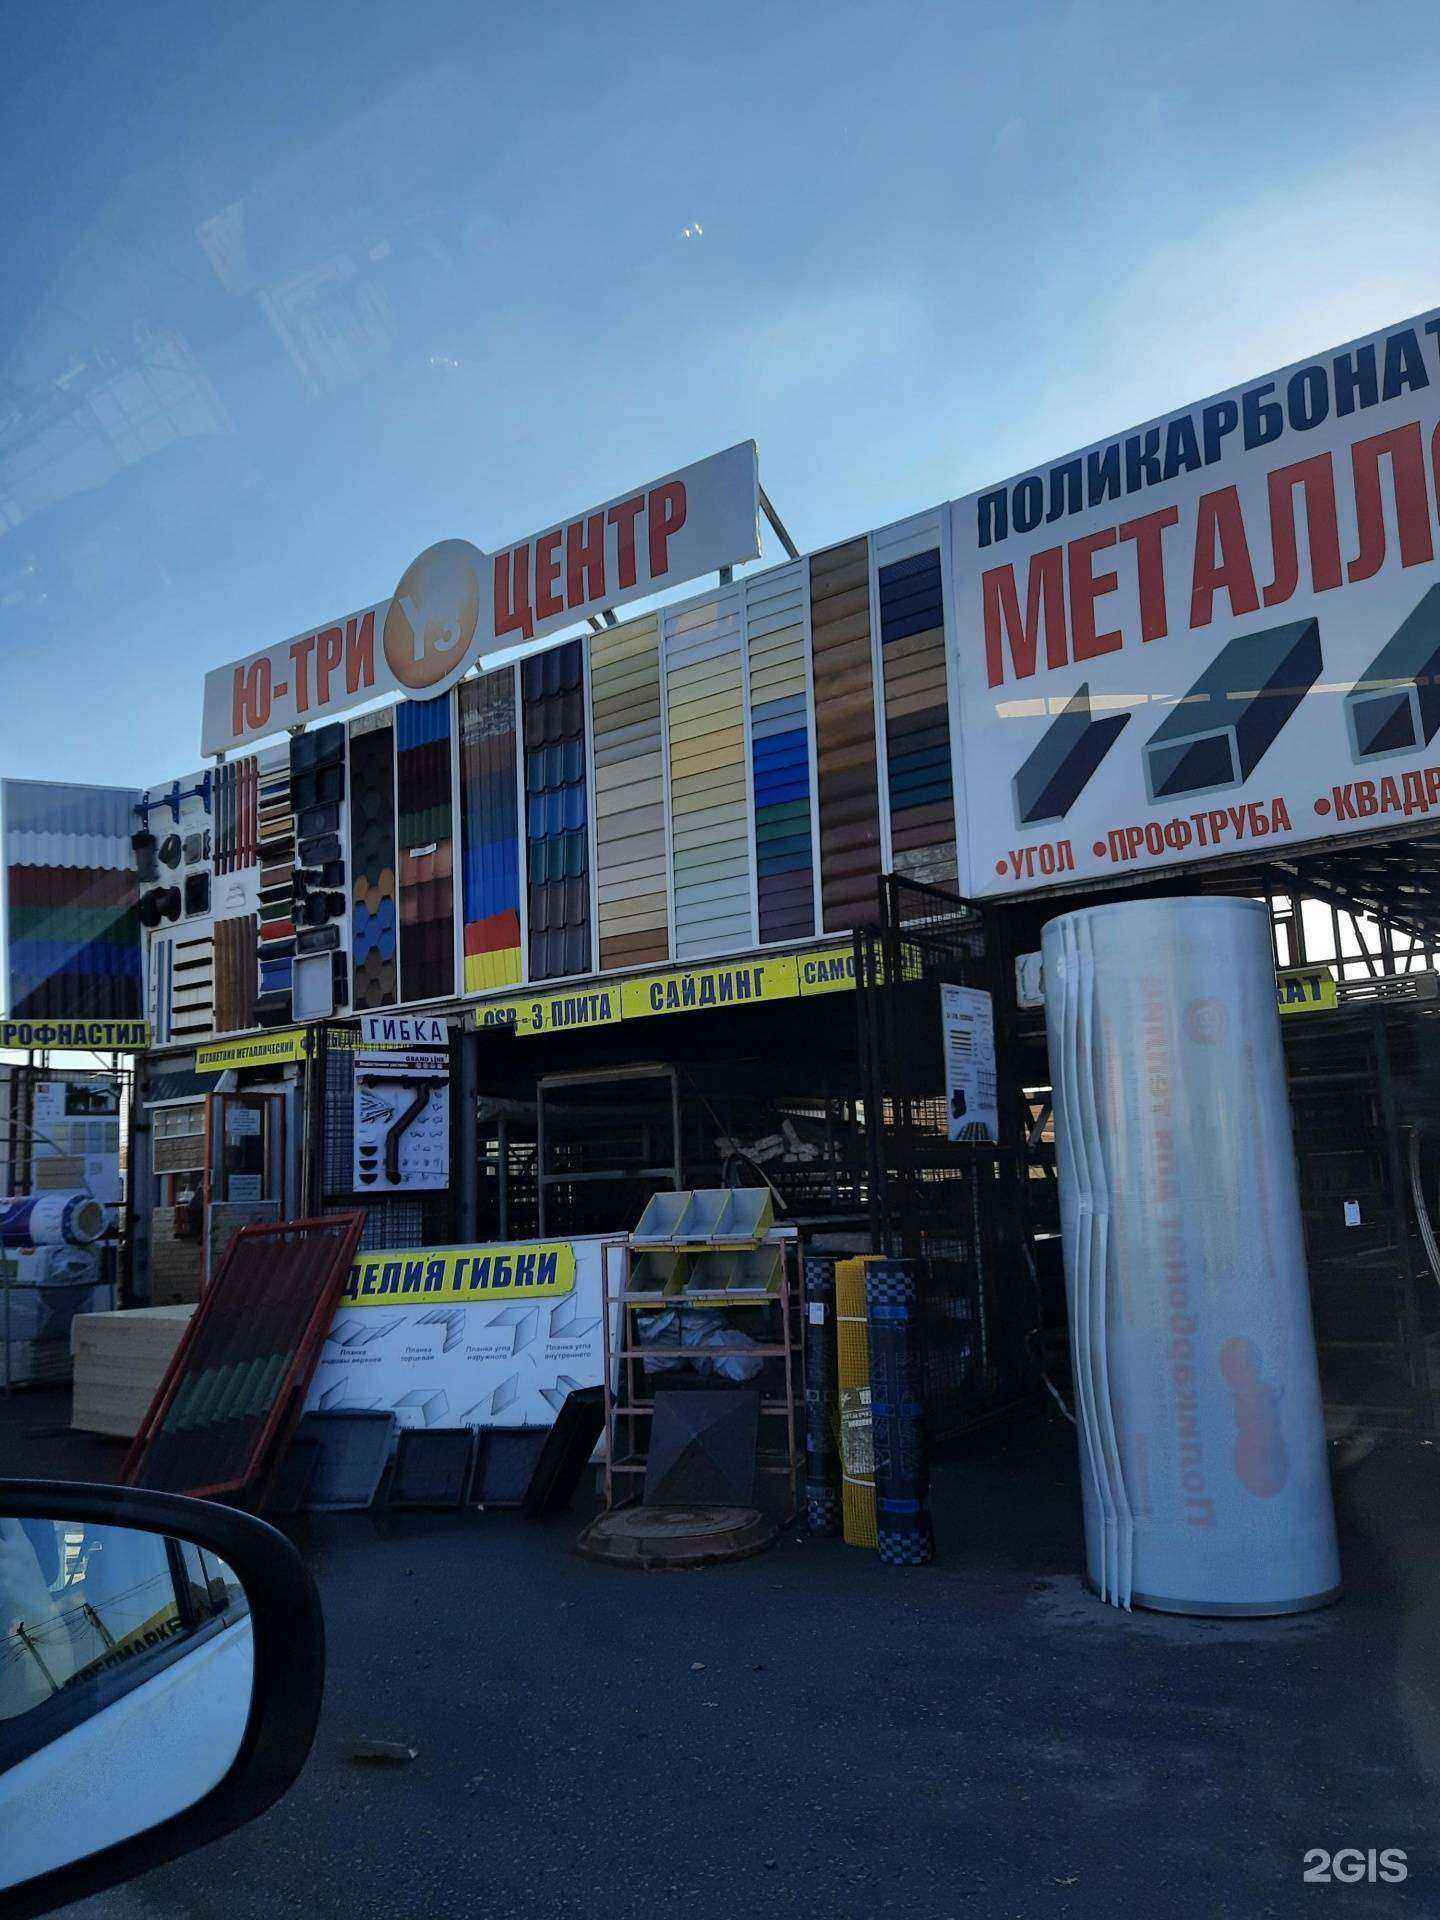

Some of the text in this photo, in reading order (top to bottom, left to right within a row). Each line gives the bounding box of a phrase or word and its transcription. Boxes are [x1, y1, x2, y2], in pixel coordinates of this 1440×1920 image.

[493, 480, 688, 640] ЦЕНТР
[981, 418, 1440, 689] МЕТАЛЛ
[232, 610, 375, 737] Ю-ТРИ
[1008, 840, 1075, 880] УГОЛ
[1107, 798, 1292, 862] ПРОФТРУБА
[551, 993, 612, 1027] ПЛИТА
[650, 967, 765, 1011] САЙДИНГ
[2, 1023, 146, 1045] РОФНАСТИЛ
[369, 1018, 443, 1042] ГИБКА
[452, 1251, 558, 1291] ГИБКИ
